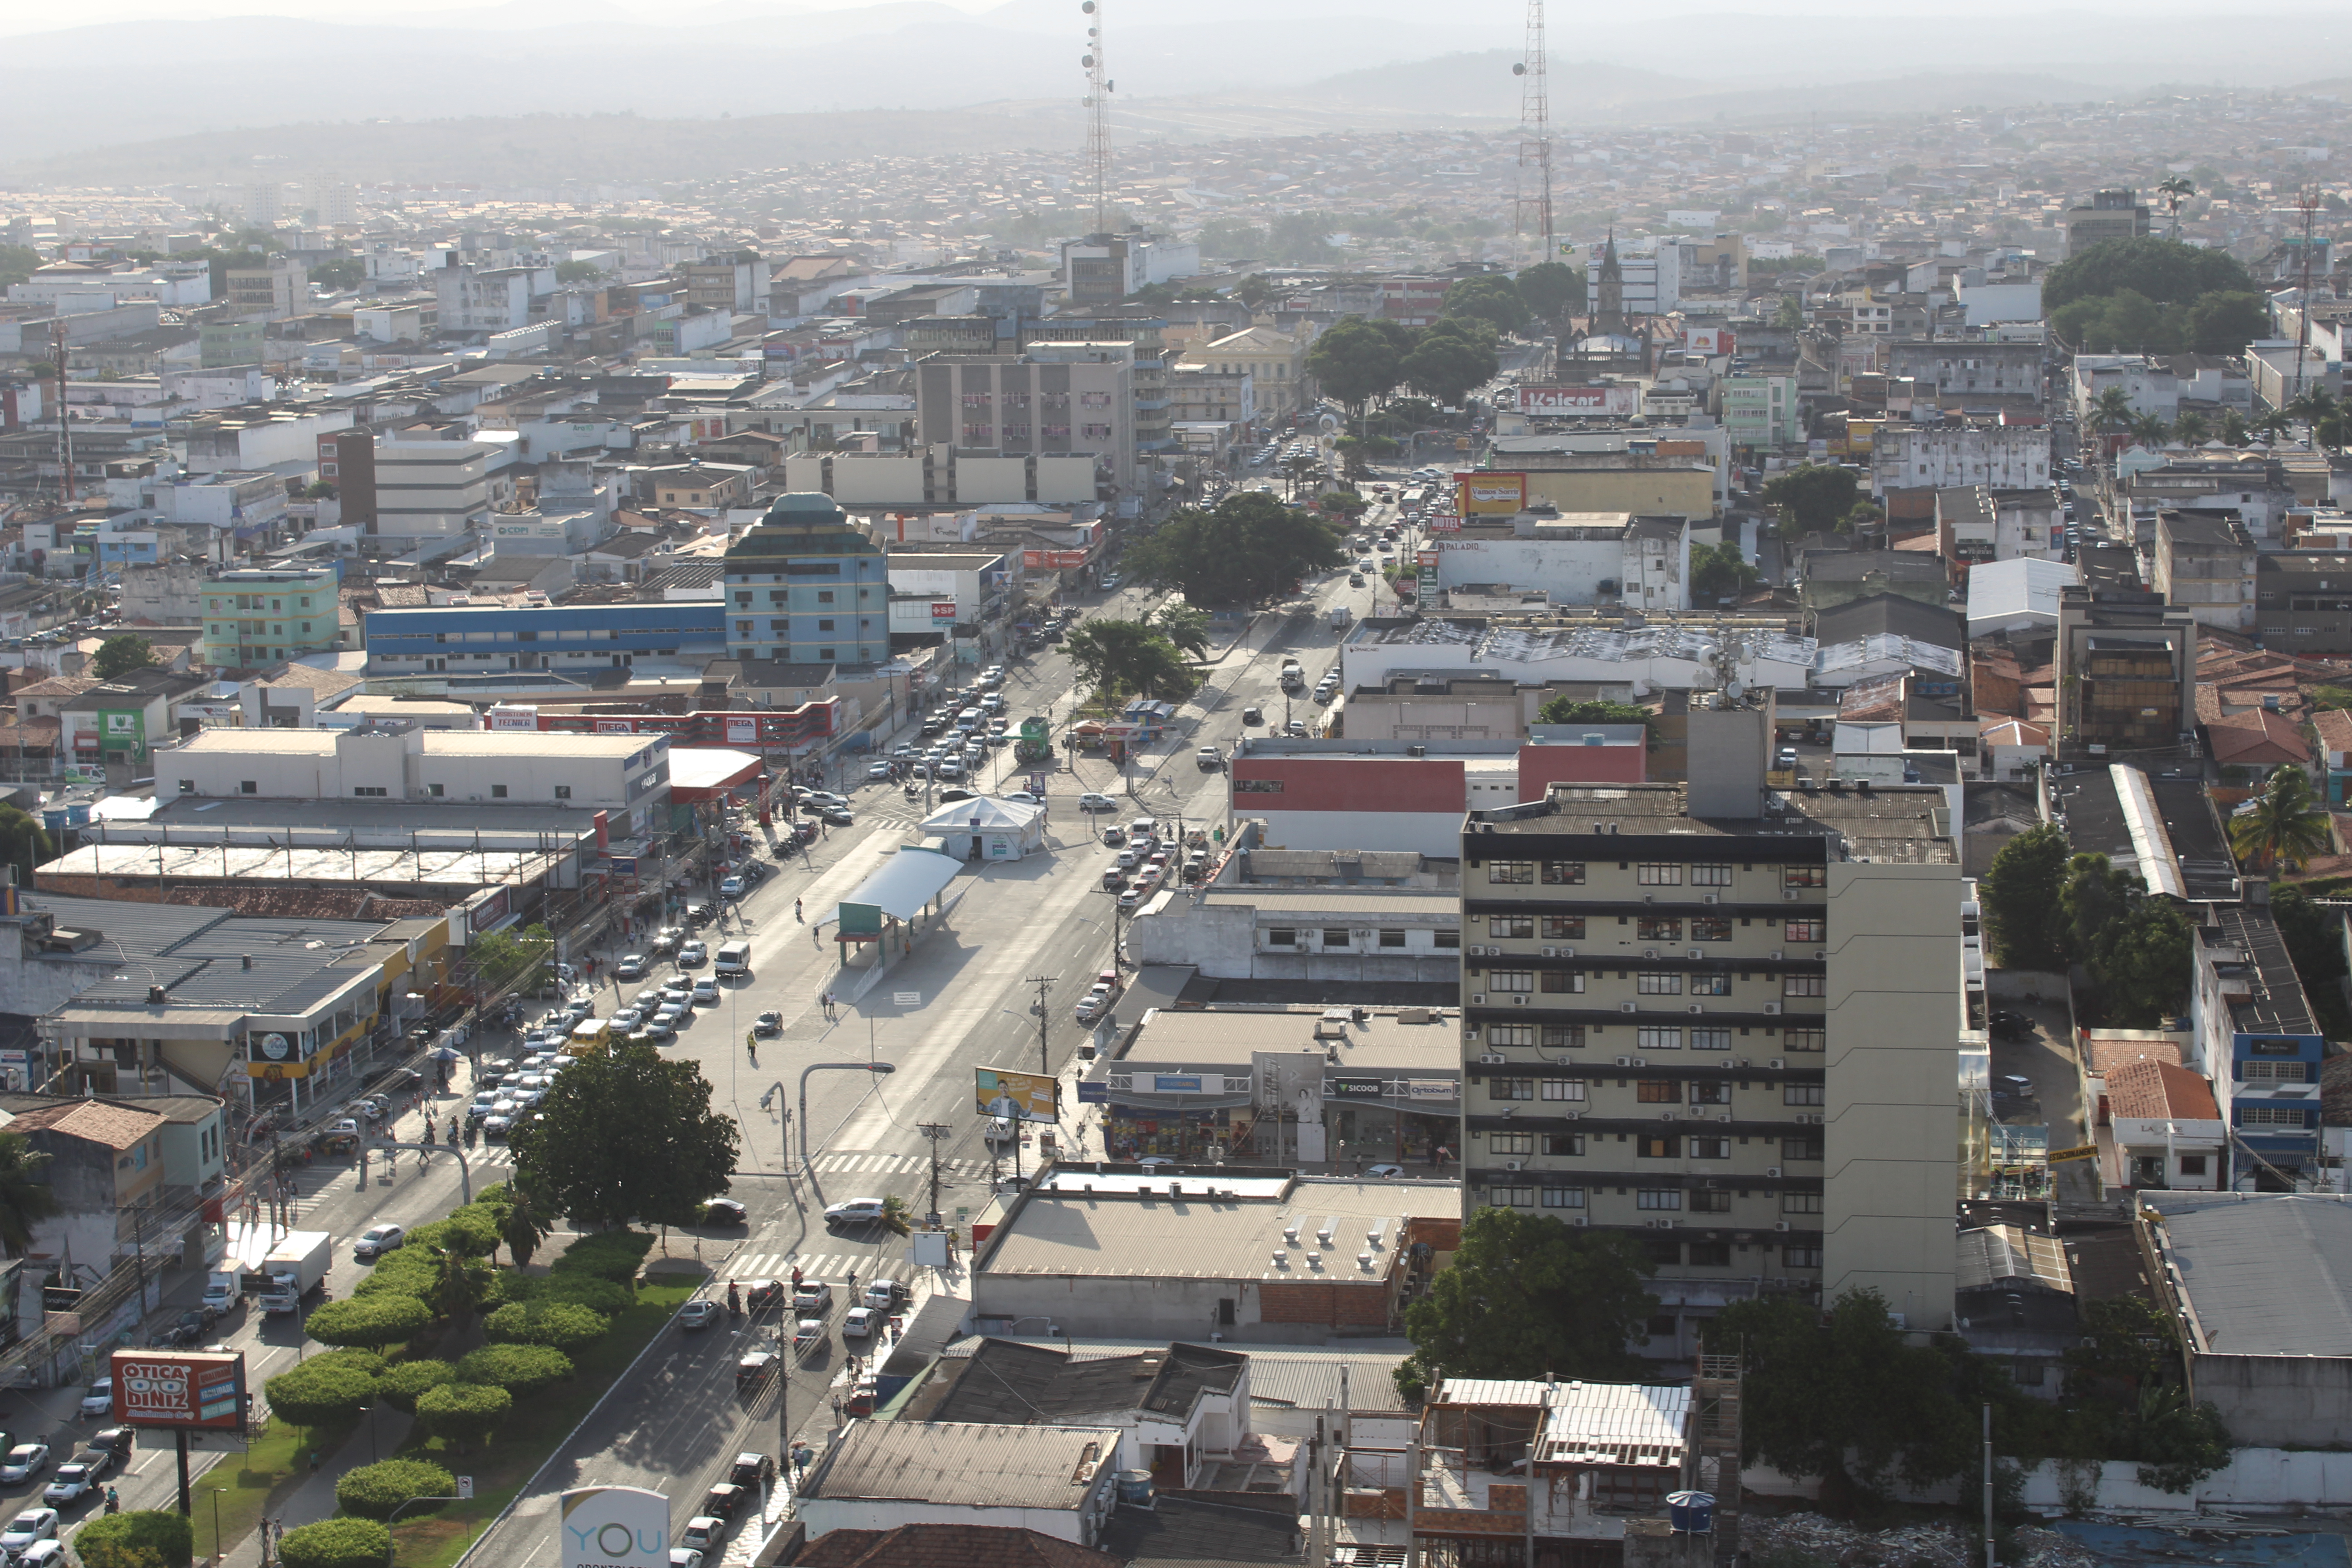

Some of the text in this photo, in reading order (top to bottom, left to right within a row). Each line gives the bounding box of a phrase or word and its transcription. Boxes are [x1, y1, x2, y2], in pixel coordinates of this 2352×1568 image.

[1432, 516, 1459, 528] HOTEL
[597, 723, 630, 733] MEGA
[727, 720, 754, 729] MEGA
[2048, 1147, 2098, 1161] ESTACIONAMENTO
[201, 1383, 234, 1399] FACILIDADE
[127, 1391, 187, 1407] DINIZ
[127, 1409, 185, 1419] Atendimento de
[568, 1522, 662, 1558] YOU
